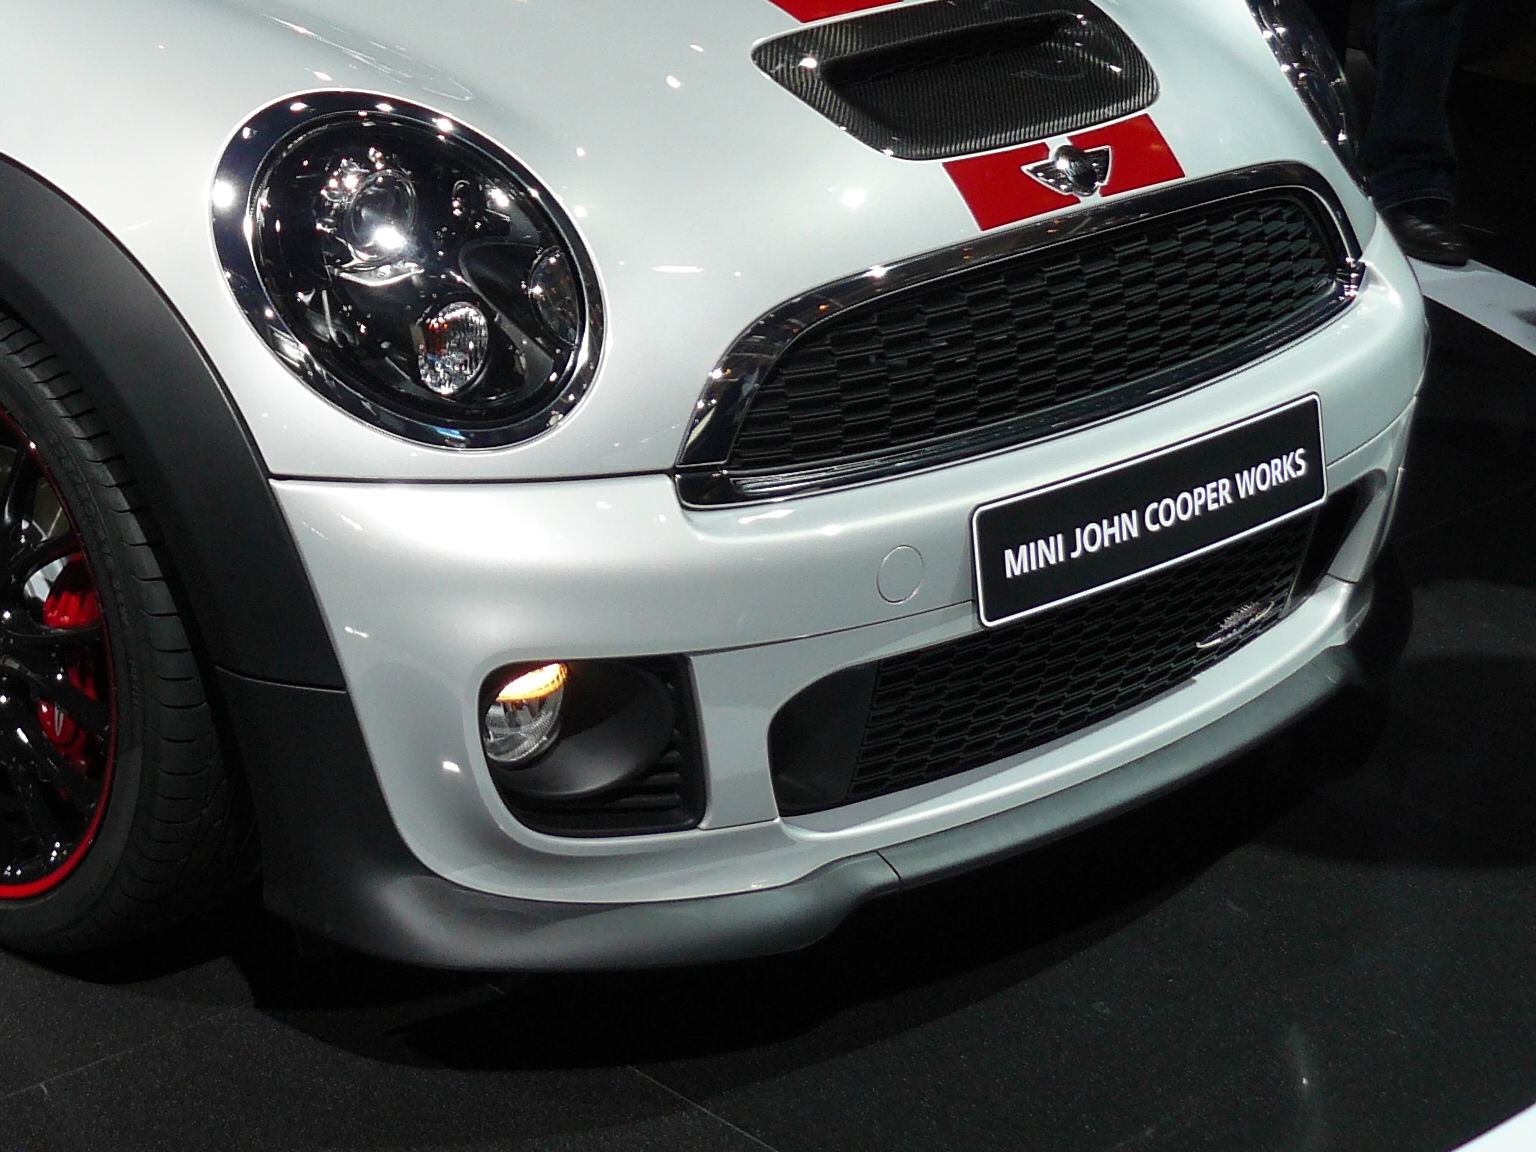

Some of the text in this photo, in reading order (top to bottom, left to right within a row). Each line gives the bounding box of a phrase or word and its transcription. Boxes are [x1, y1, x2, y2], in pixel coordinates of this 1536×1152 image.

[1004, 448, 1307, 579] MINI JOHN COOPER WORKS
